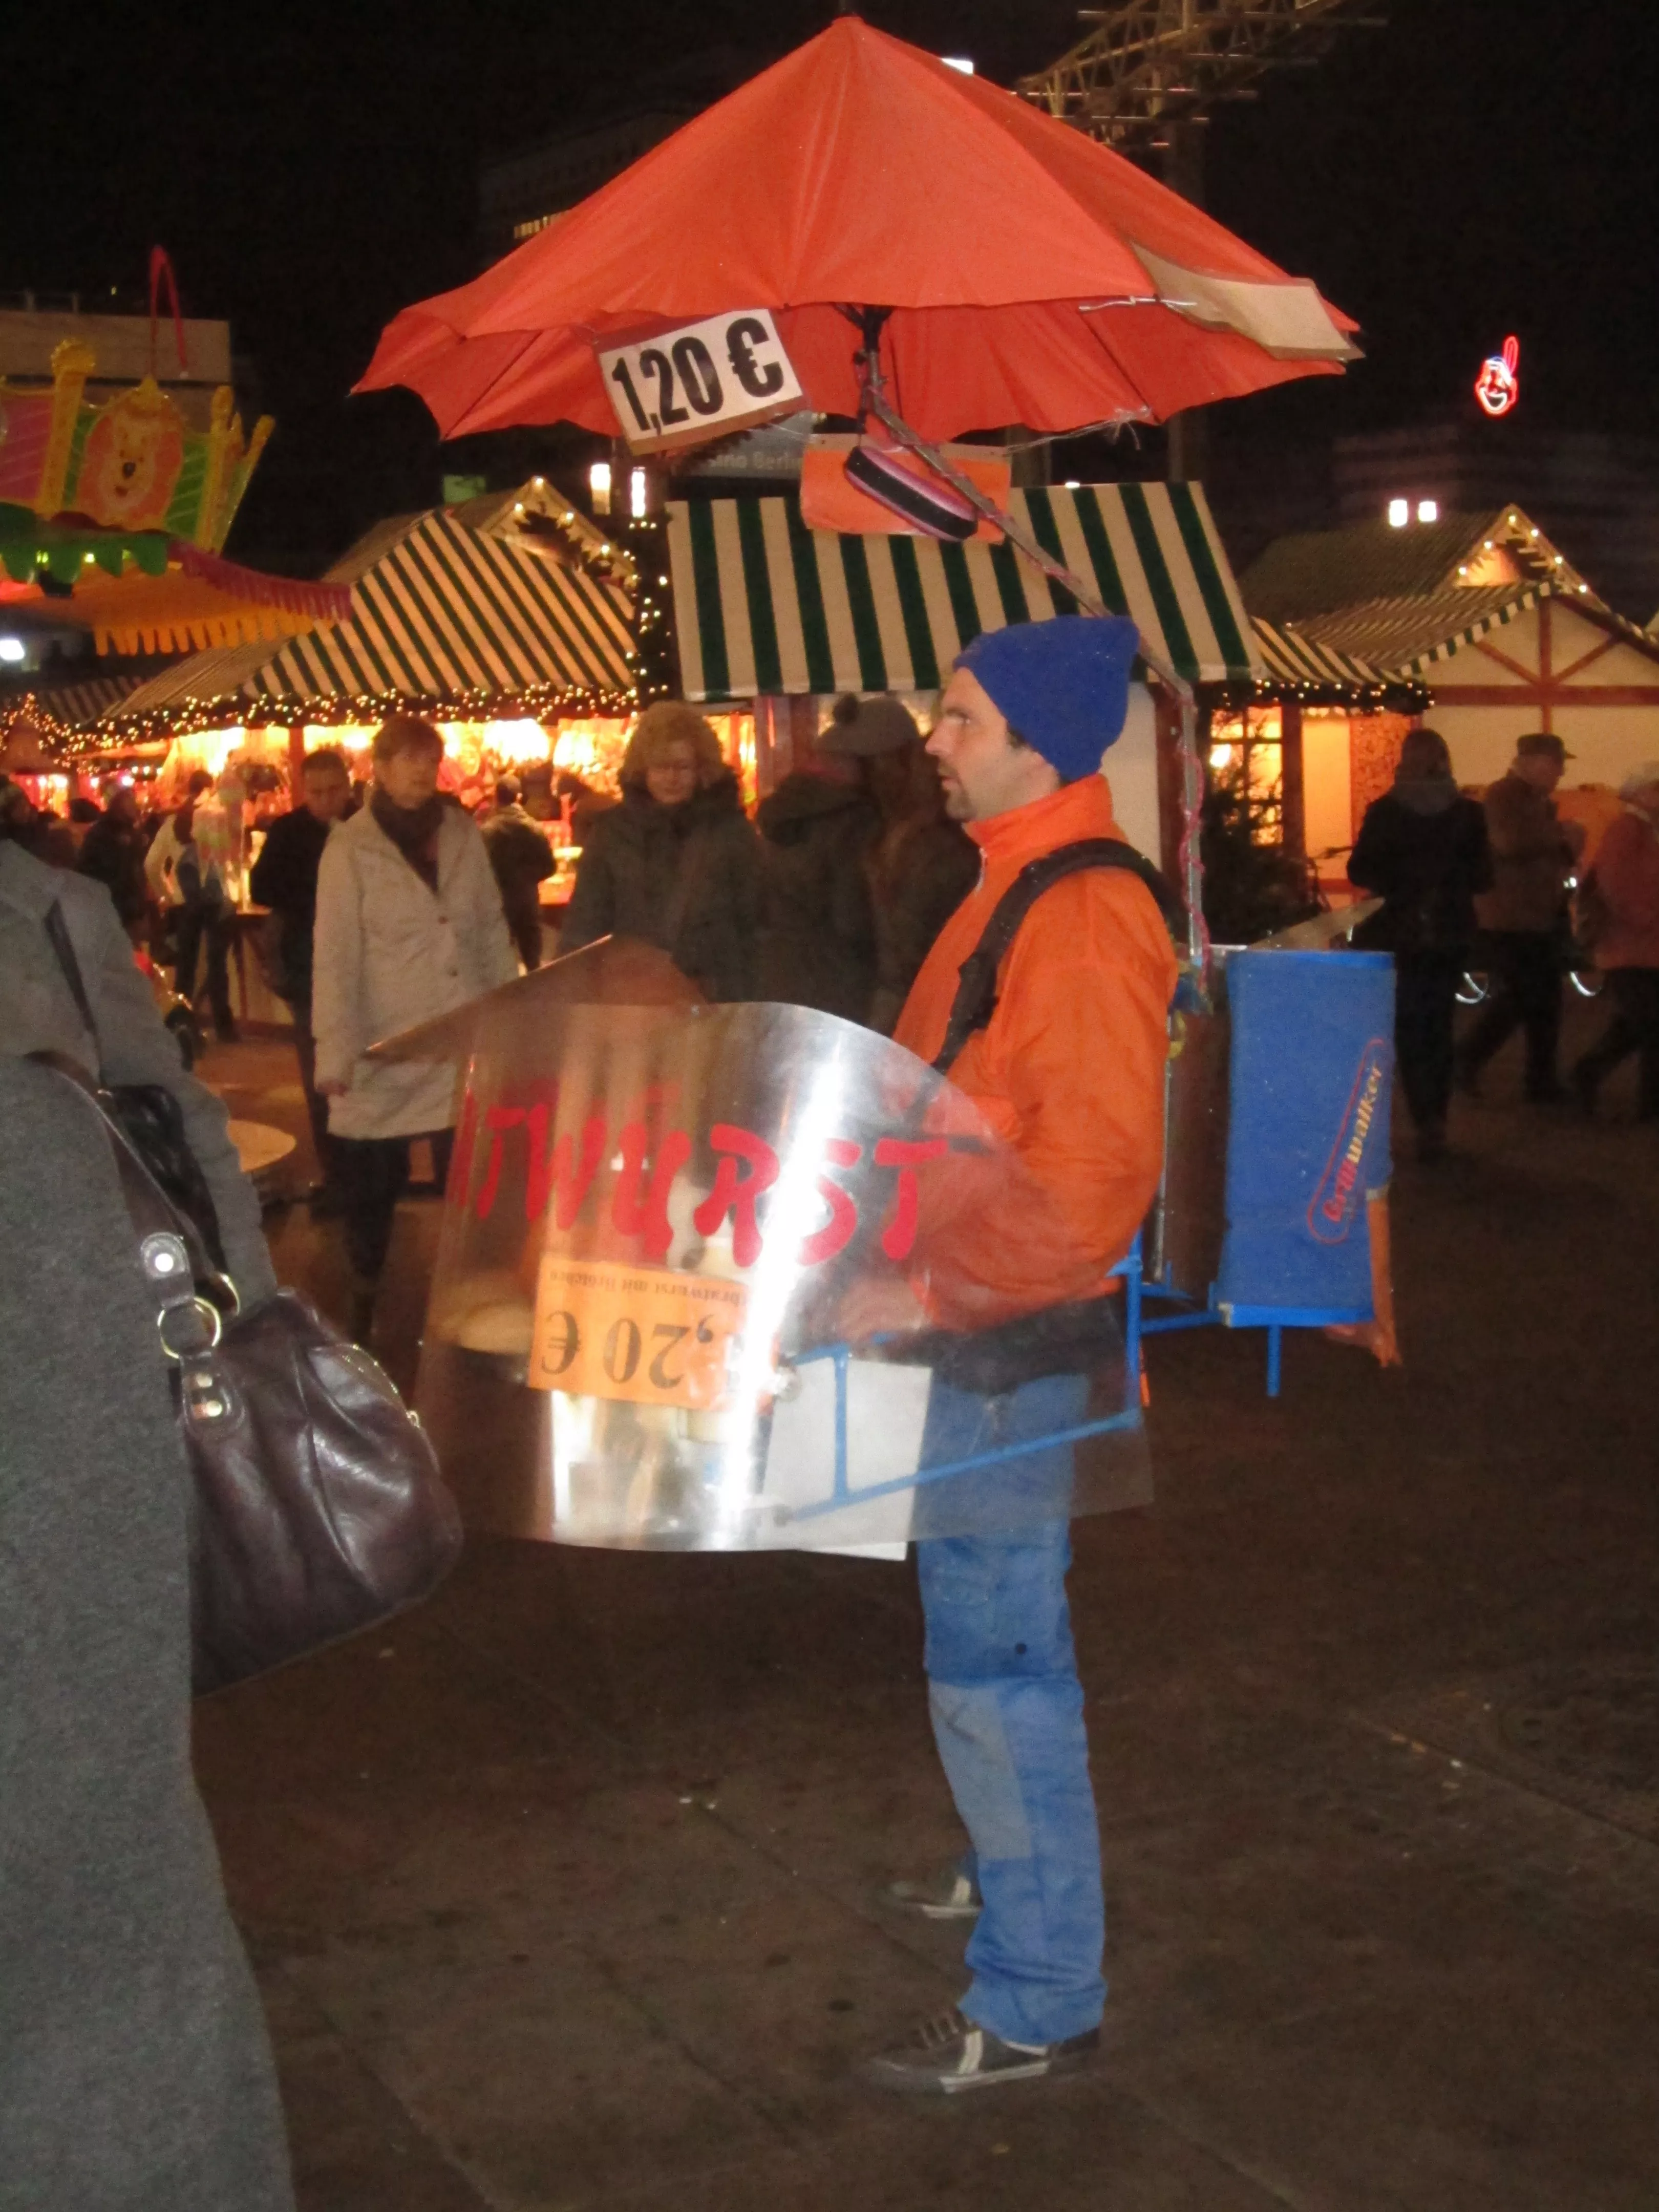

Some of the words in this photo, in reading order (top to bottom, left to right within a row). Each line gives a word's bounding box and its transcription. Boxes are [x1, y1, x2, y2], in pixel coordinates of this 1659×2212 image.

[612, 336, 724, 436] 1,20
[725, 317, 784, 398] €
[453, 1088, 948, 1267] TWURST
[541, 1309, 580, 1375] €
[603, 1313, 717, 1390] ,20
